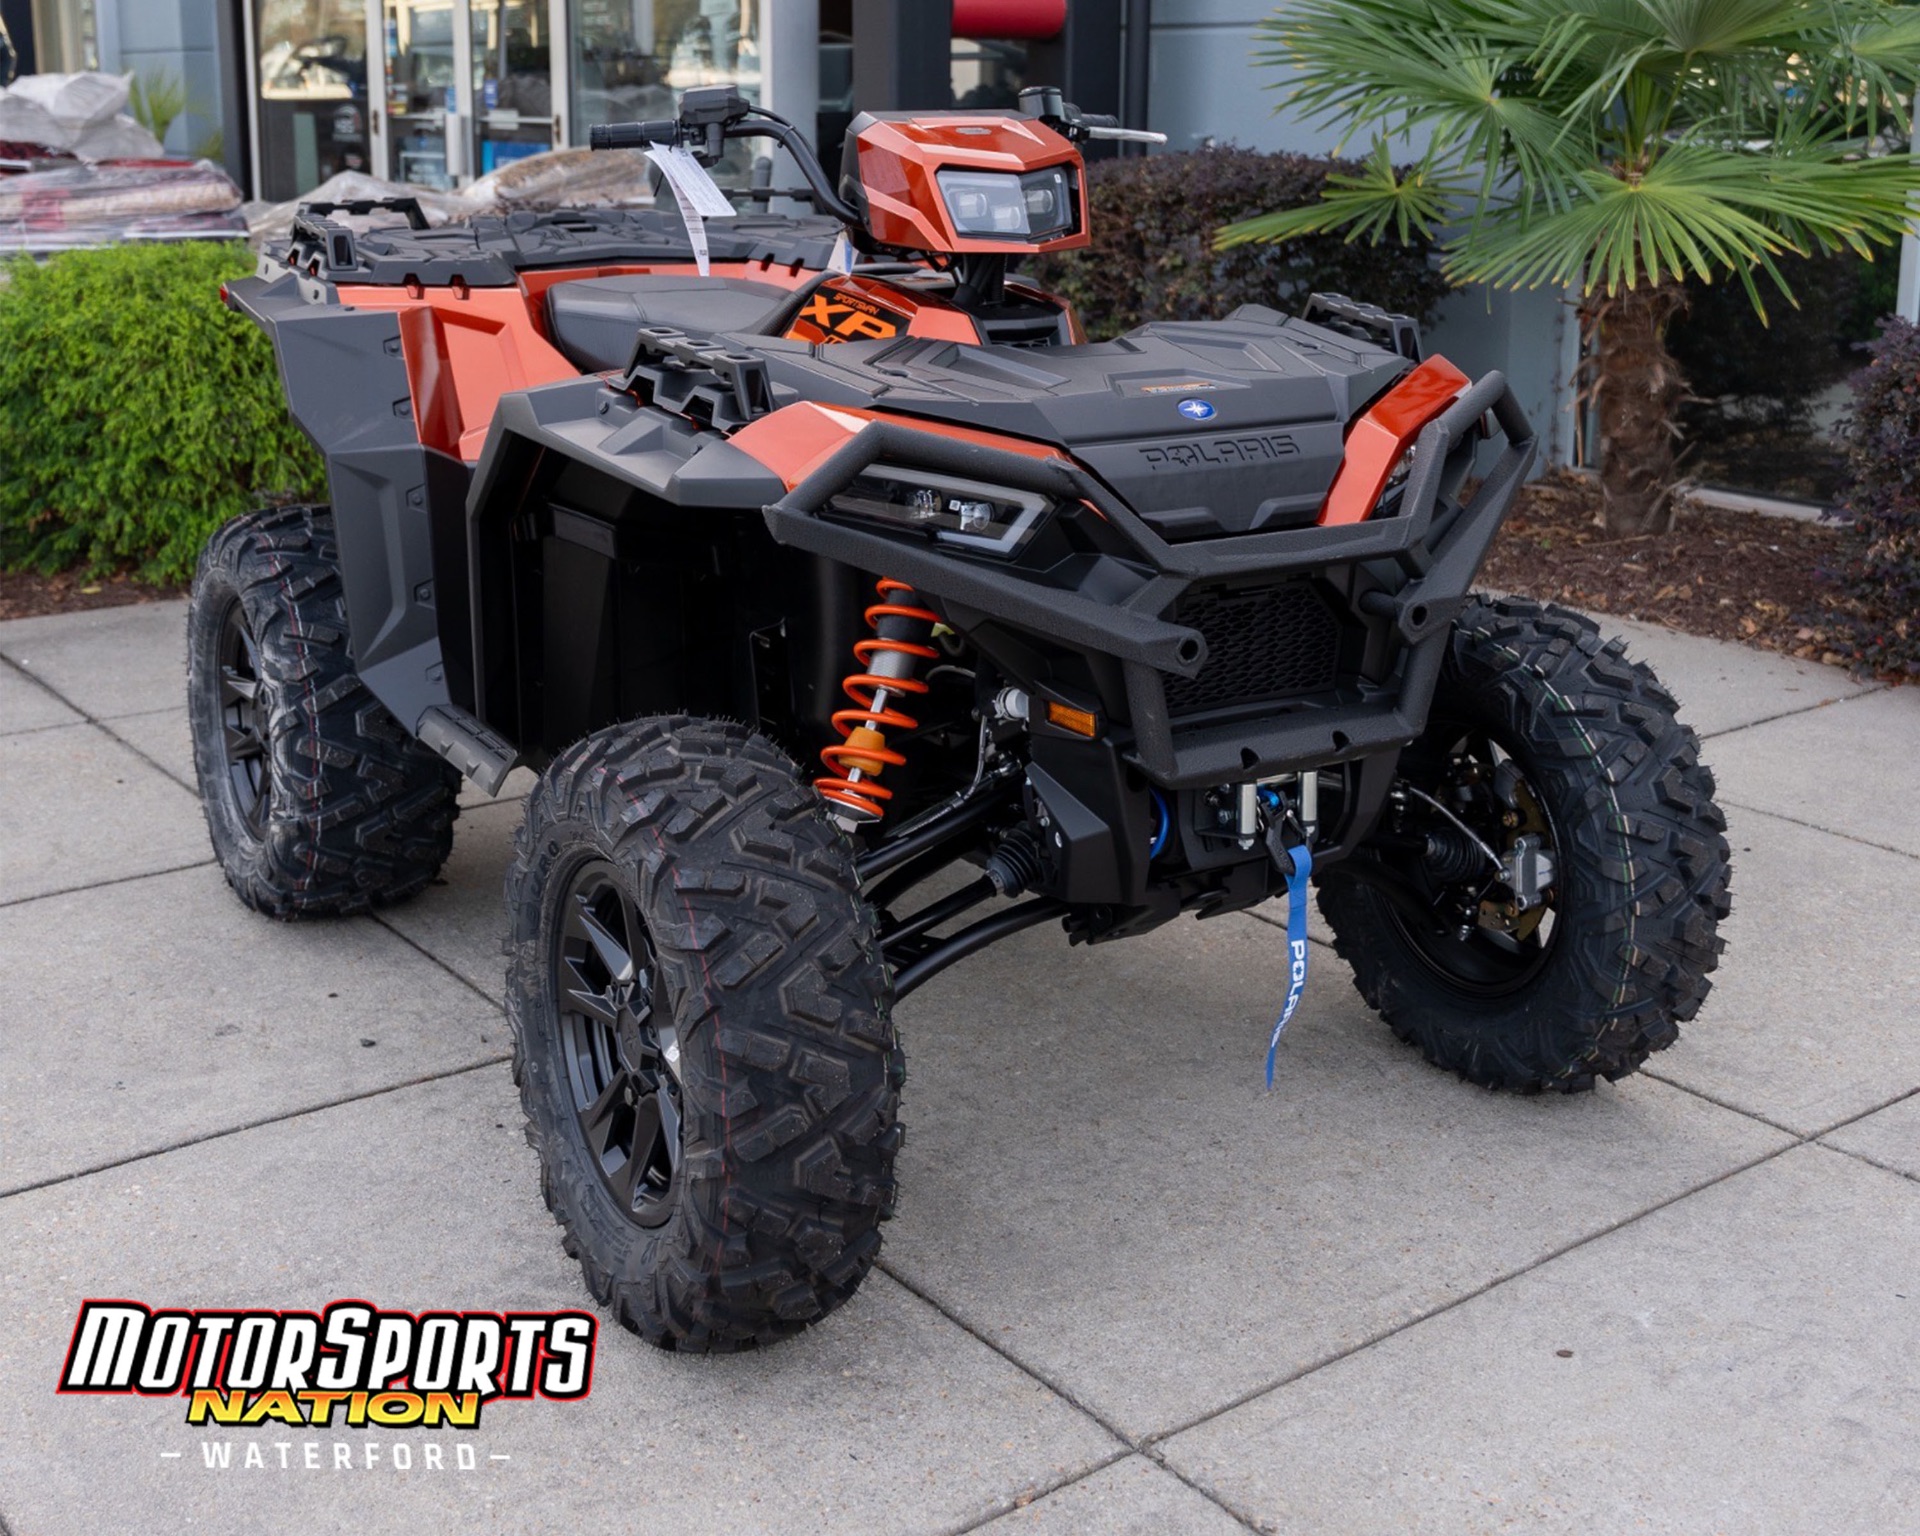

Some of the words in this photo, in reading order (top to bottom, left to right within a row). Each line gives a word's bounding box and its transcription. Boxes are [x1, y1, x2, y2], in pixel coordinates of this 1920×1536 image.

[800, 294, 897, 340] XP
[833, 292, 880, 316] SPORTSMAN
[1139, 435, 1301, 470] POLARIS
